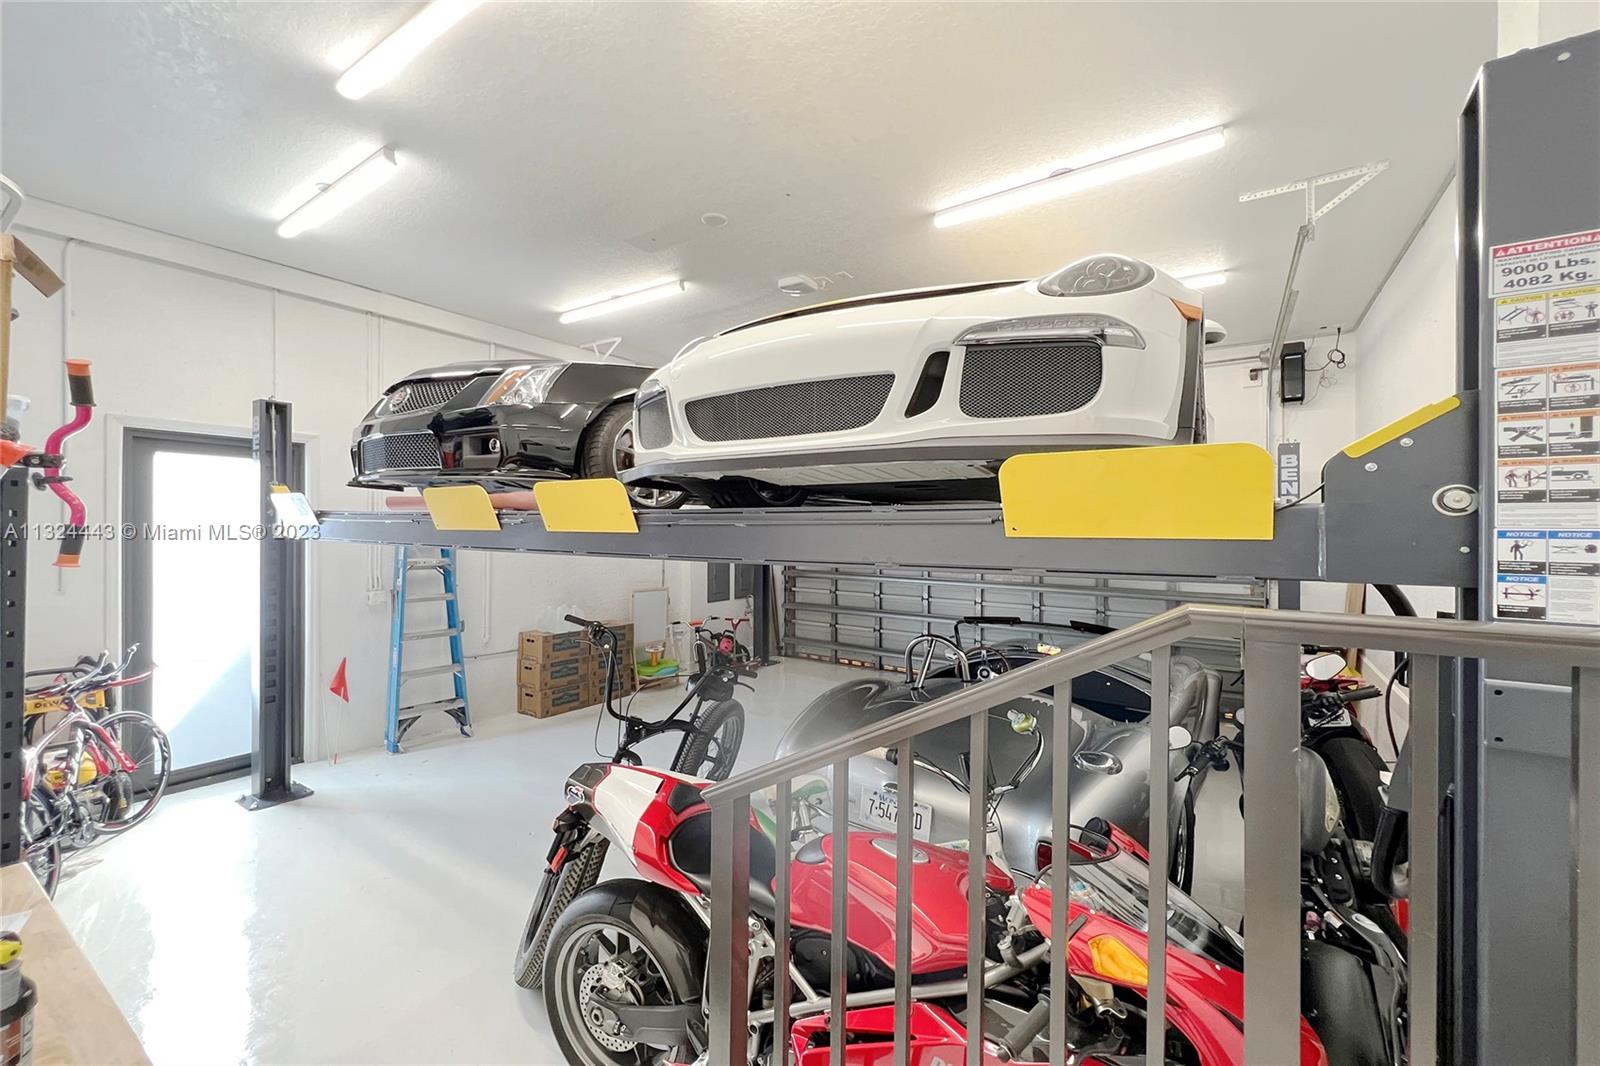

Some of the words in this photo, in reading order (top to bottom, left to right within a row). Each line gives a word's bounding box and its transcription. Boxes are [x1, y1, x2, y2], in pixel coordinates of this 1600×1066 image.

[1507, 234, 1593, 255] ATTENTION
[1501, 261, 1549, 277] 9000
[1555, 256, 1597, 270] Lbs.
[1503, 274, 1553, 289] 4082
[1560, 271, 1593, 282] Kg.
